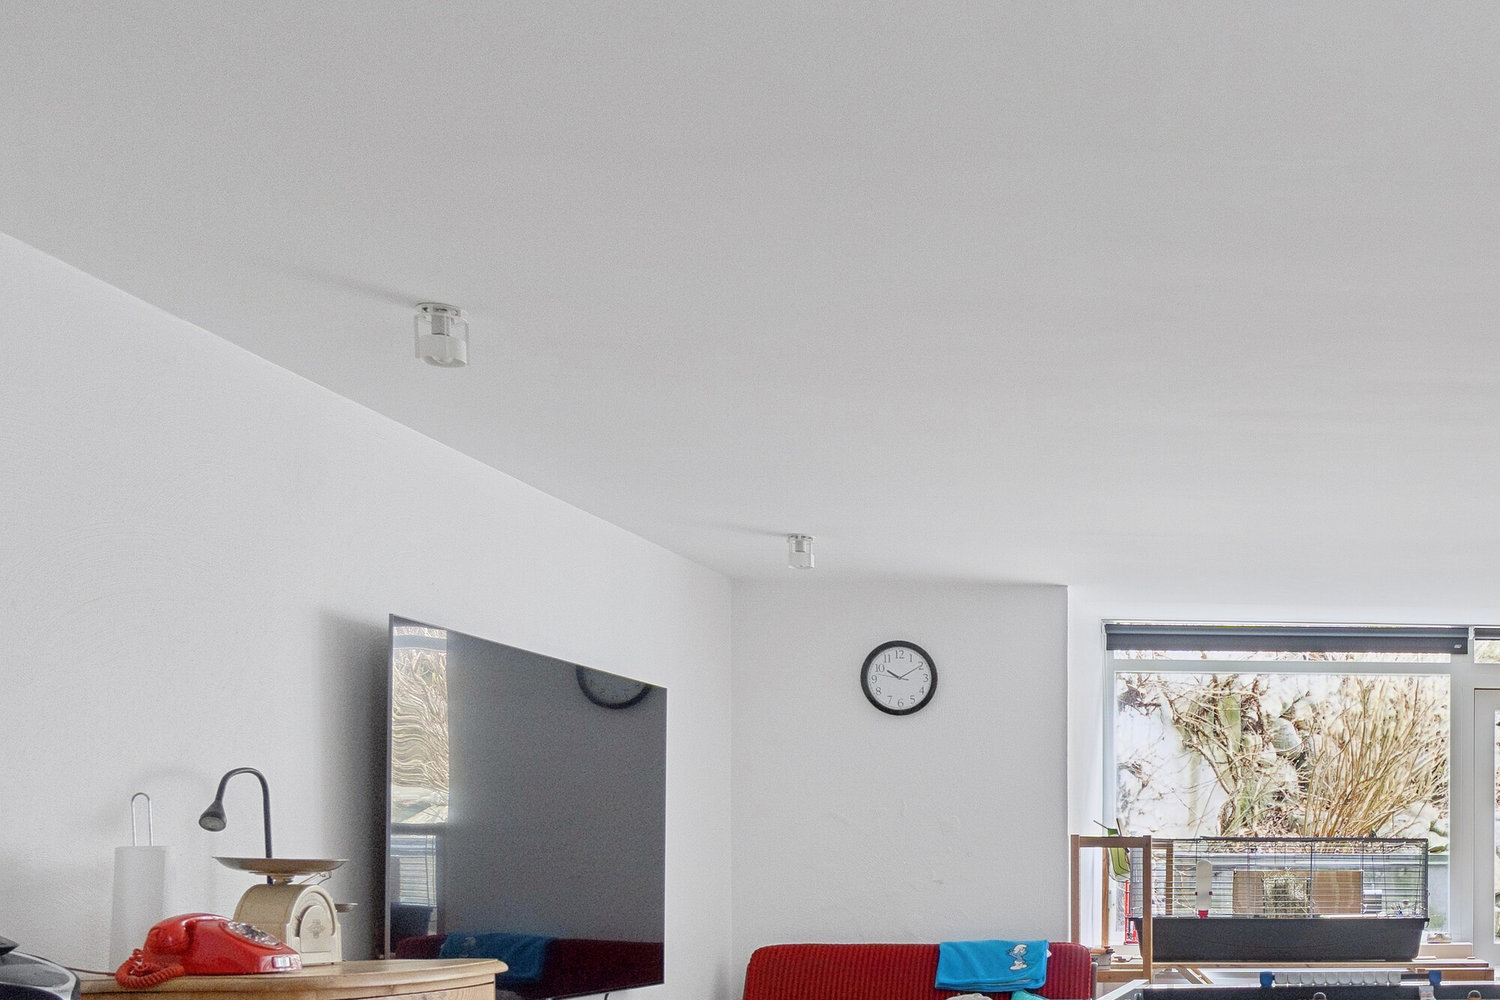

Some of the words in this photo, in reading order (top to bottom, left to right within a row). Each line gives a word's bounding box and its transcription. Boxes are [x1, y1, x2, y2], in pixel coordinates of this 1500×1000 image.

[884, 654, 891, 663] 11
[895, 650, 904, 659] 12
[909, 654, 912, 662] 1
[875, 664, 884, 672] 10
[919, 661, 923, 670] 2
[871, 675, 877, 683] 9
[923, 674, 928, 682] 3
[876, 687, 881, 695] 8
[888, 696, 892, 704] 7
[898, 699, 904, 707] 6
[910, 696, 915, 704] 5
